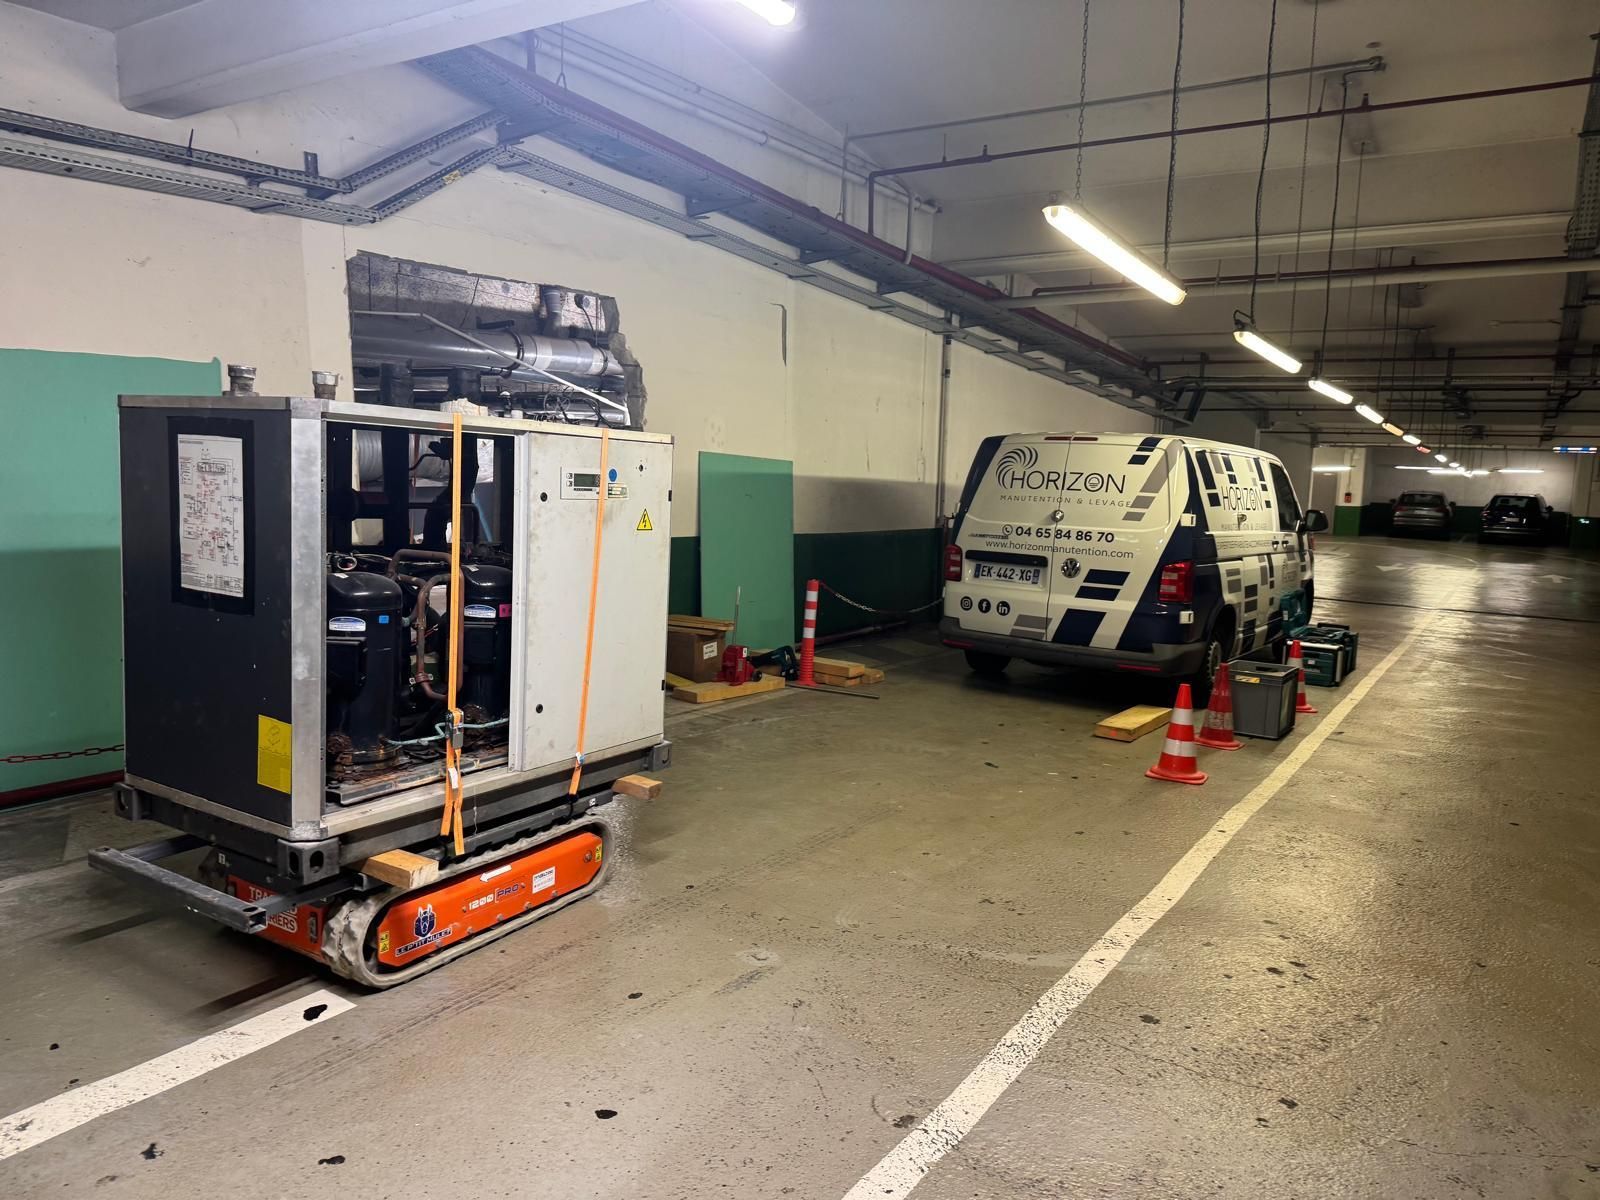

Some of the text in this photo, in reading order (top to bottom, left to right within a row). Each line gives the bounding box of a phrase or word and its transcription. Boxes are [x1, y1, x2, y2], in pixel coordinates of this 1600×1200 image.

[1010, 470, 1126, 494] HORIZON
[1000, 495, 1071, 504] MANUTENTION
[1089, 499, 1131, 508] LEVAGE
[1221, 485, 1264, 511] HORIZON
[1015, 526, 1114, 543] 04 65 84 86 70
[985, 539, 1134, 559] www.horizonmanutention.com
[980, 564, 1032, 582] EK-442-XG
[496, 883, 520, 899] PRO
[268, 913, 296, 932] RIERS
